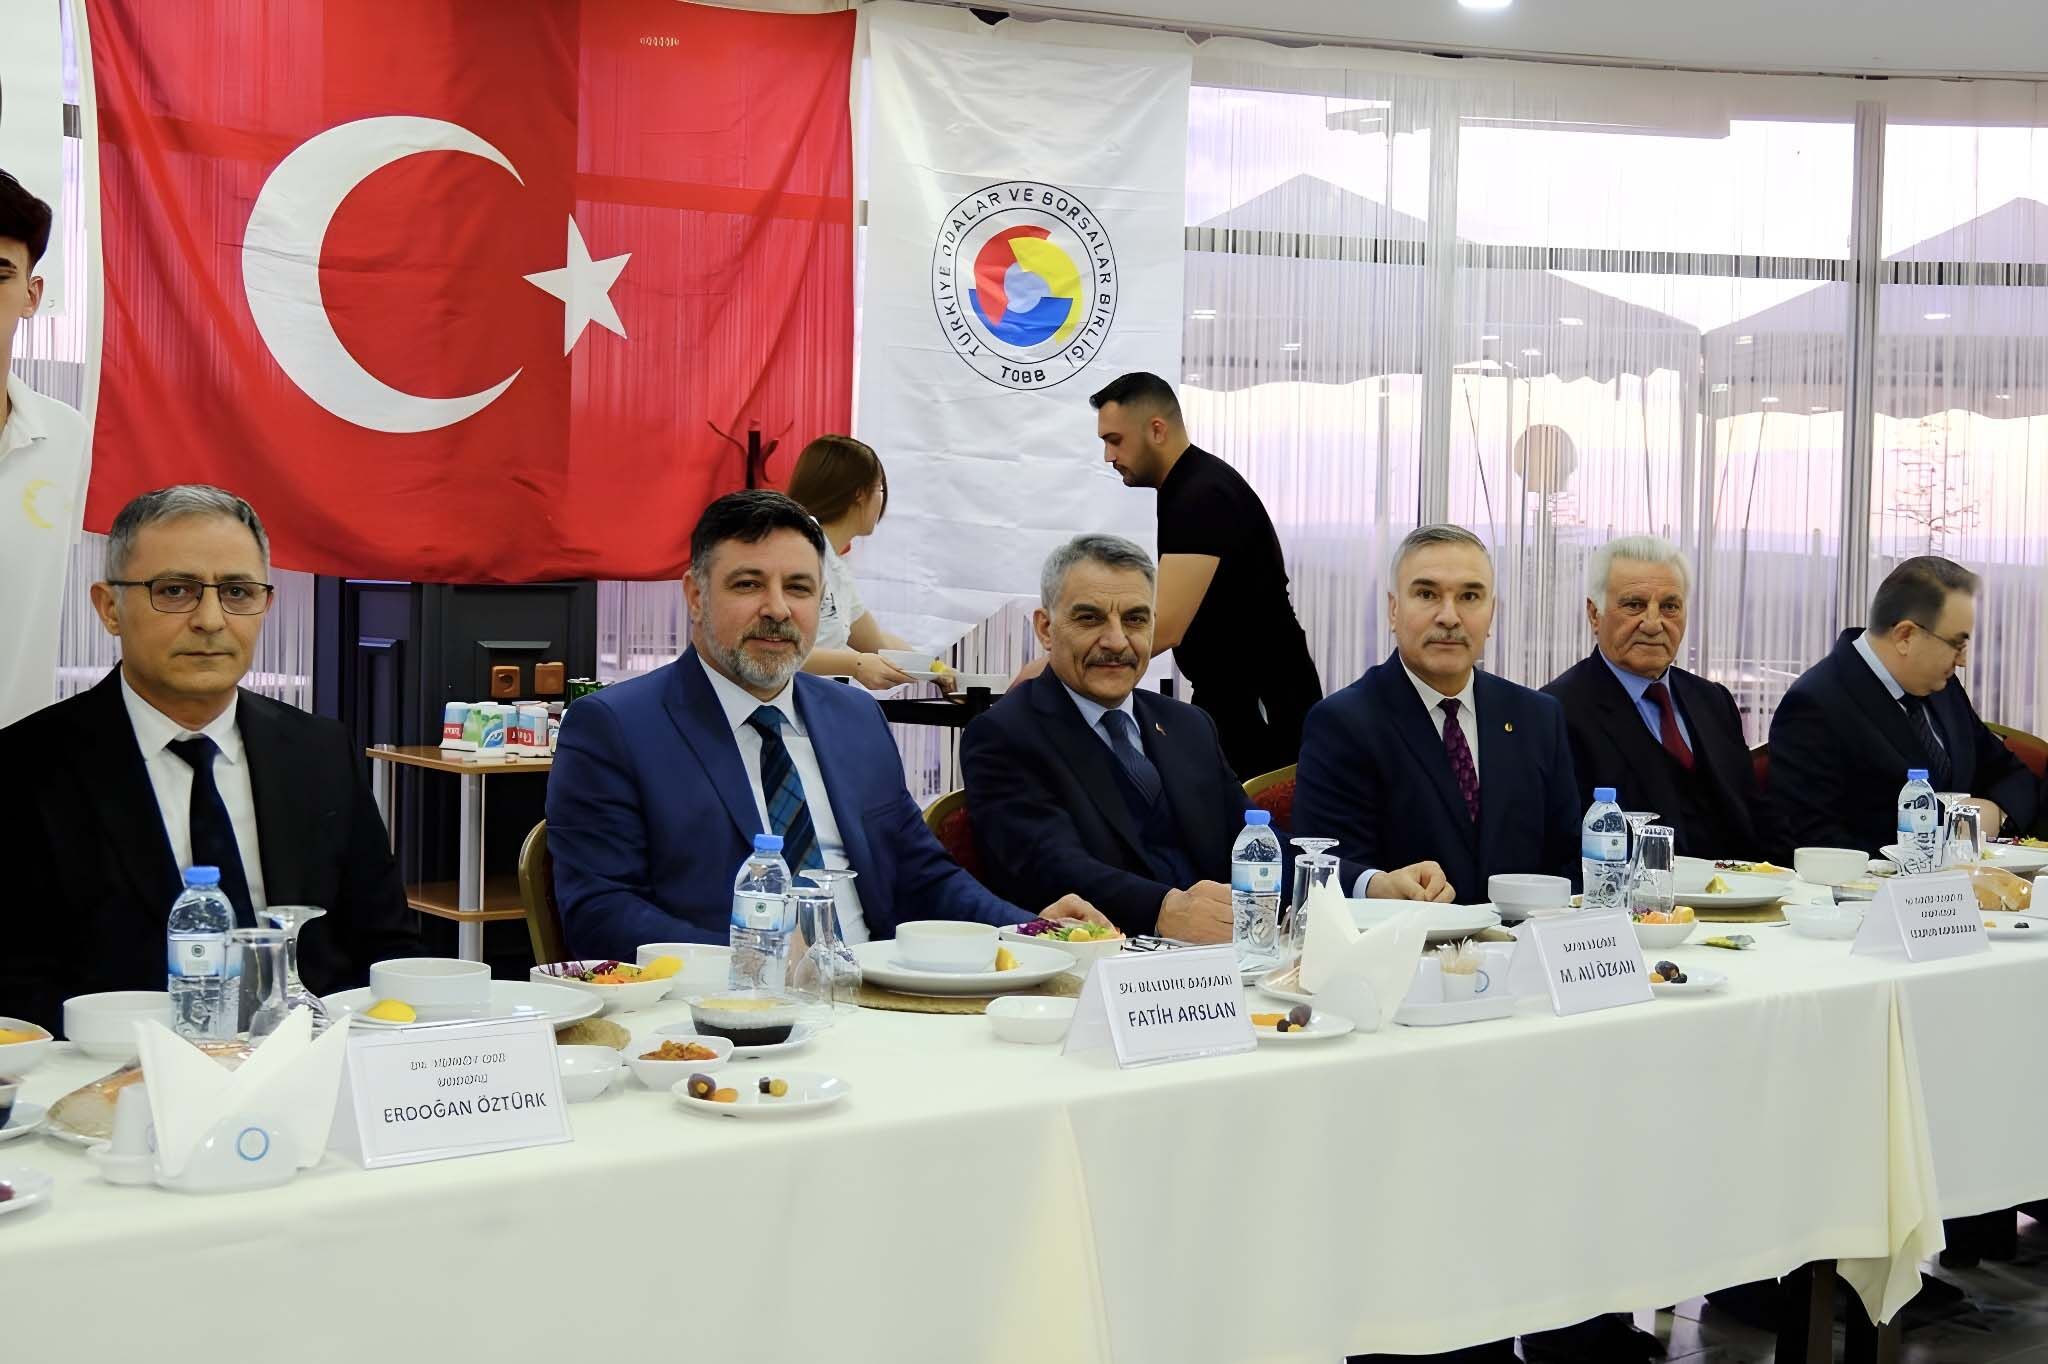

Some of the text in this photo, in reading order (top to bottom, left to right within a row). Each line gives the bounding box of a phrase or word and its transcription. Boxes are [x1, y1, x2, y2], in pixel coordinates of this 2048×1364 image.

[942, 192, 1001, 257] ODALAR
[1008, 188, 1034, 202] VE
[1041, 191, 1112, 284] BORSALAR
[1001, 365, 1046, 384] TOBB
[1128, 1000, 1236, 1027] FATİH ARSLAN
[383, 1090, 547, 1123] ERDOĞAN ÖZTÜRK
